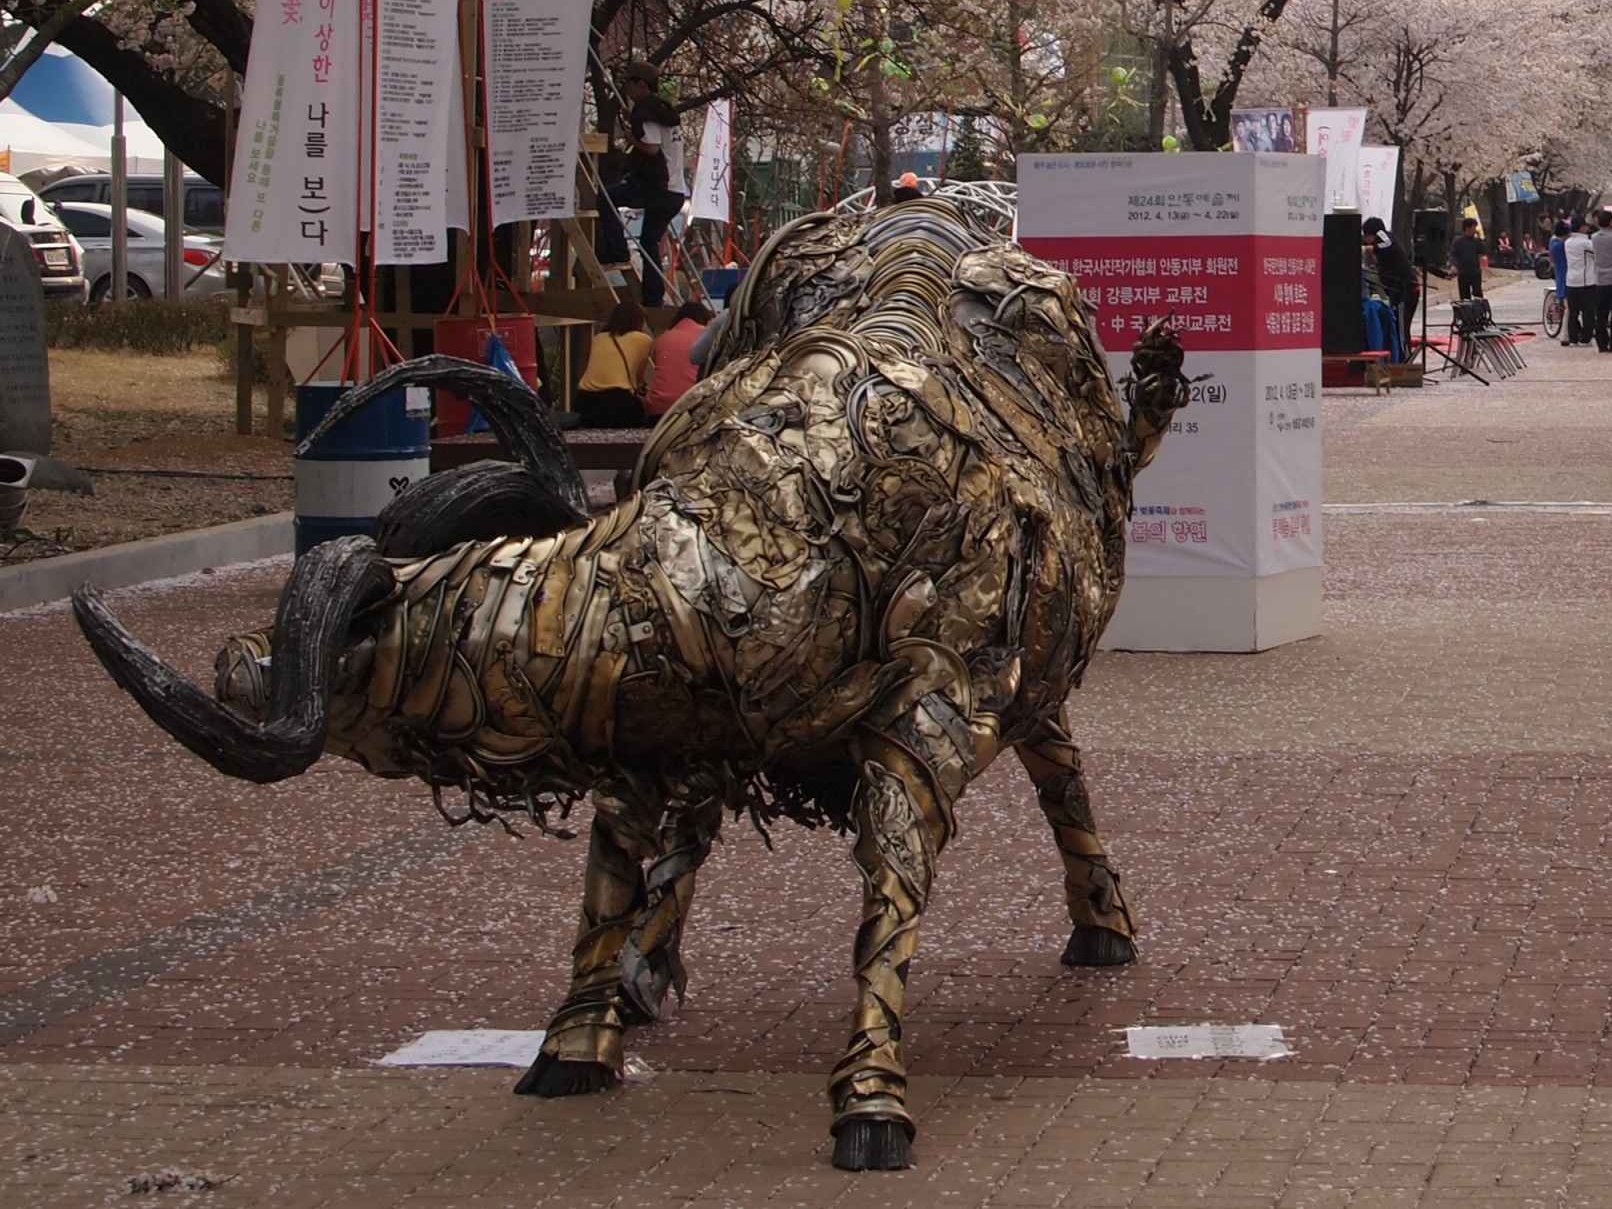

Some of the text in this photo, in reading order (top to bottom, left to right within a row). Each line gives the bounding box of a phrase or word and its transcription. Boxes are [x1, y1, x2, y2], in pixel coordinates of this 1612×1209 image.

[303, 102, 330, 158] 나를
[1127, 193, 1240, 207] 제24회 안동예술제
[297, 177, 332, 246] 보)다
[1072, 258, 1156, 276] 한국사진작가협회
[1159, 258, 1203, 276] 안동지부
[1206, 257, 1239, 275] 회원전
[1106, 286, 1161, 305] 강릉지부
[1164, 285, 1208, 304] 교류전
[1186, 422, 1199, 433] 35
[1130, 520, 1208, 543] 봄의 향연
